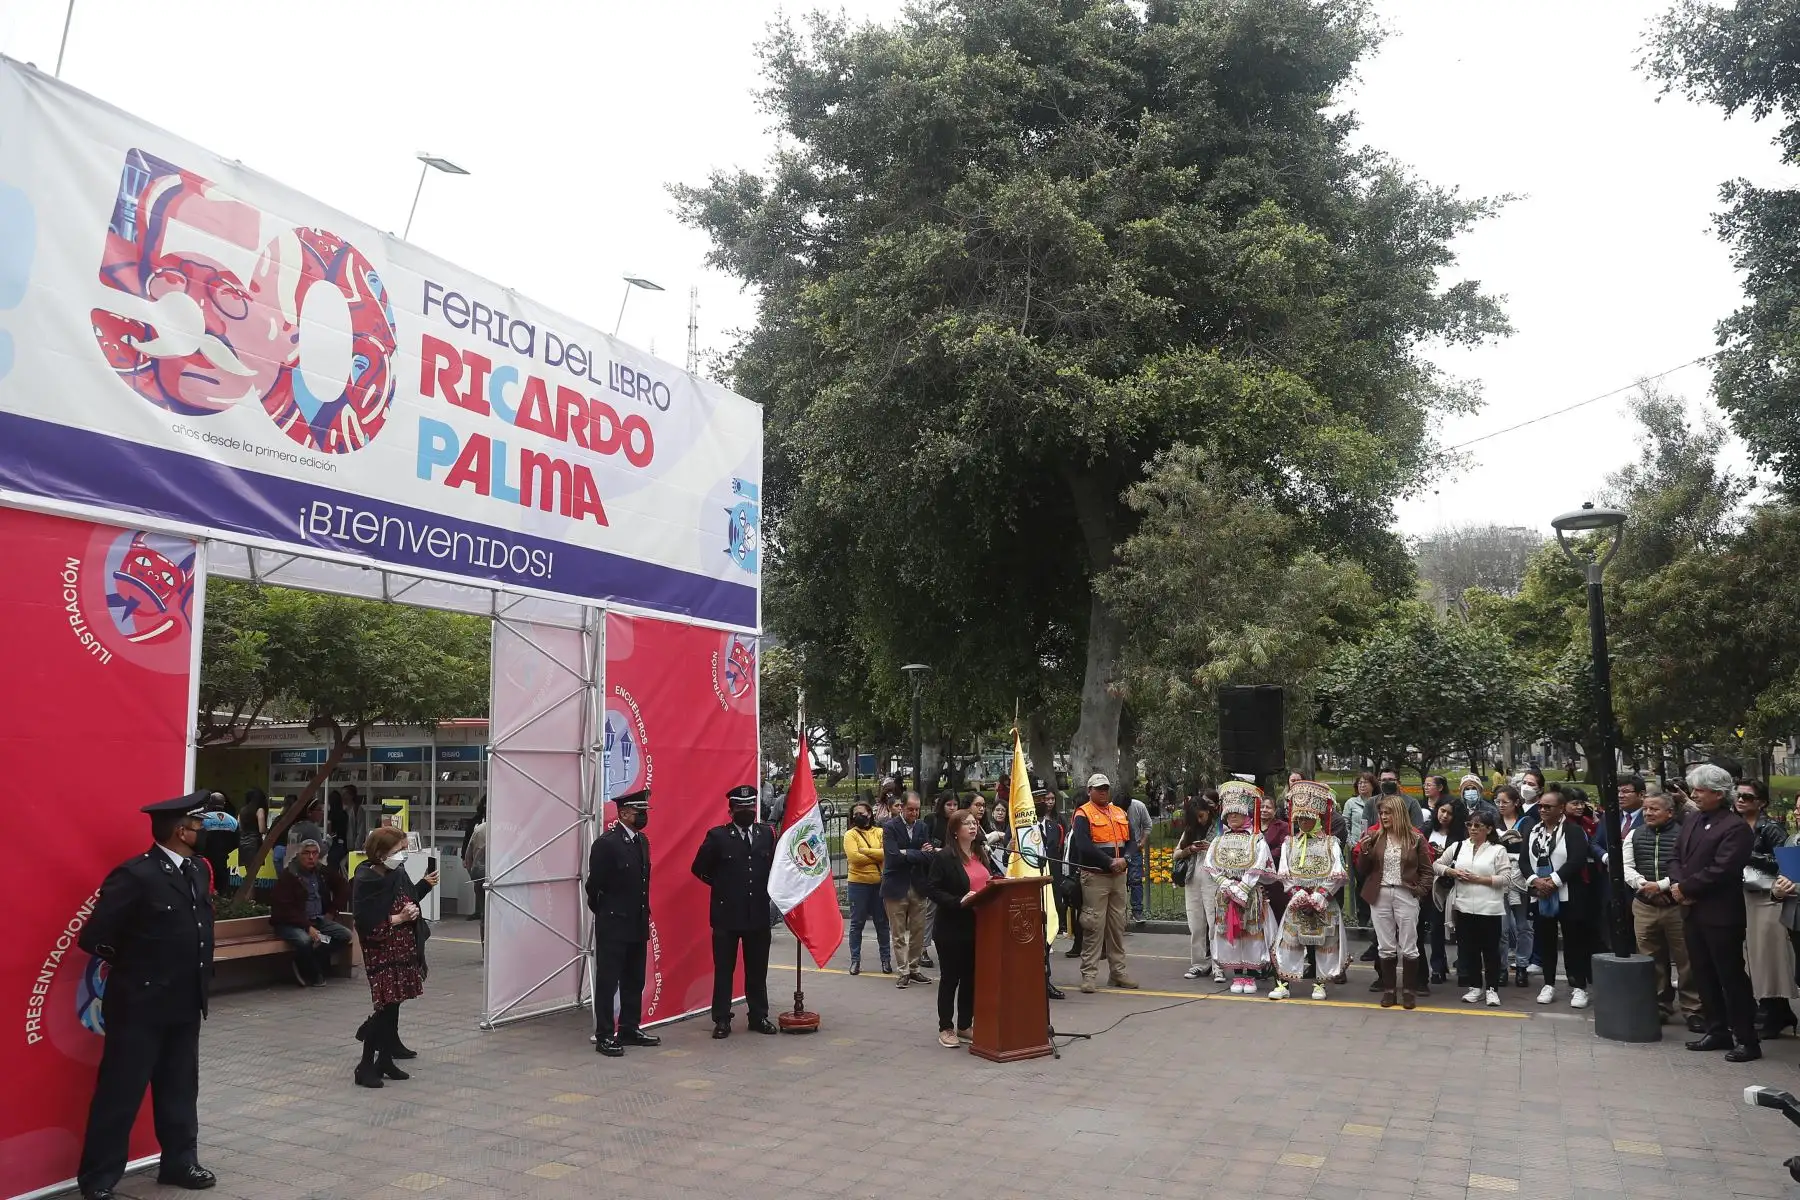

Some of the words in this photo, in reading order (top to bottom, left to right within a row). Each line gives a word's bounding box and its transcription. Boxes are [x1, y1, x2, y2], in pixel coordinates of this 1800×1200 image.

[90, 147, 397, 454] 50
[419, 333, 655, 468] RICARDO
[609, 360, 670, 411] LIBRO
[172, 422, 200, 440] años
[202, 431, 240, 449] desde
[242, 440, 253, 452] la
[255, 446, 297, 463] primera
[300, 456, 337, 472] edición
[60, 556, 113, 665] ILUSTRACIÓN
[615, 685, 648, 745] ENCUENTROS
[647, 972, 662, 1017] ENSAYO
